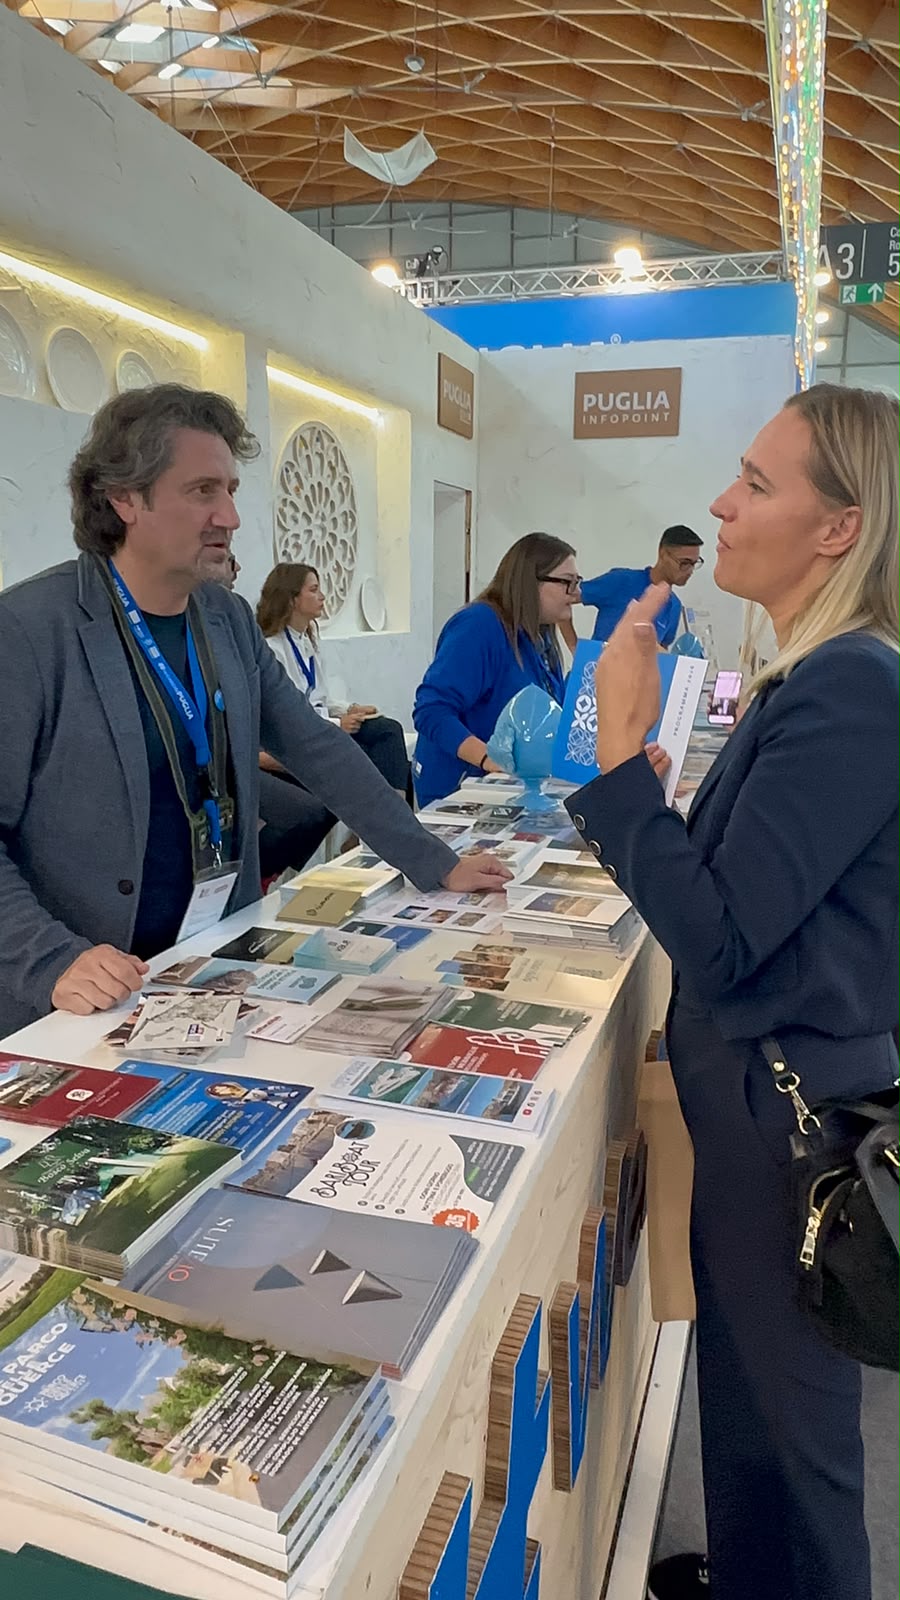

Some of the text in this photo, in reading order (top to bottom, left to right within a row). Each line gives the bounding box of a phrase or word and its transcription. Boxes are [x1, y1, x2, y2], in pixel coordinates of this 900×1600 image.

[582, 412, 670, 425] INFOPOINT
[583, 390, 670, 412] PUGLIA
[673, 686, 689, 736] PROGRAMMA
[65, 1148, 91, 1168] Selva
[342, 1158, 380, 1187] TOUR
[188, 1215, 235, 1263] SUITE
[2, 1322, 68, 1374] PARCO
[0, 1342, 76, 1406] QUERCE
